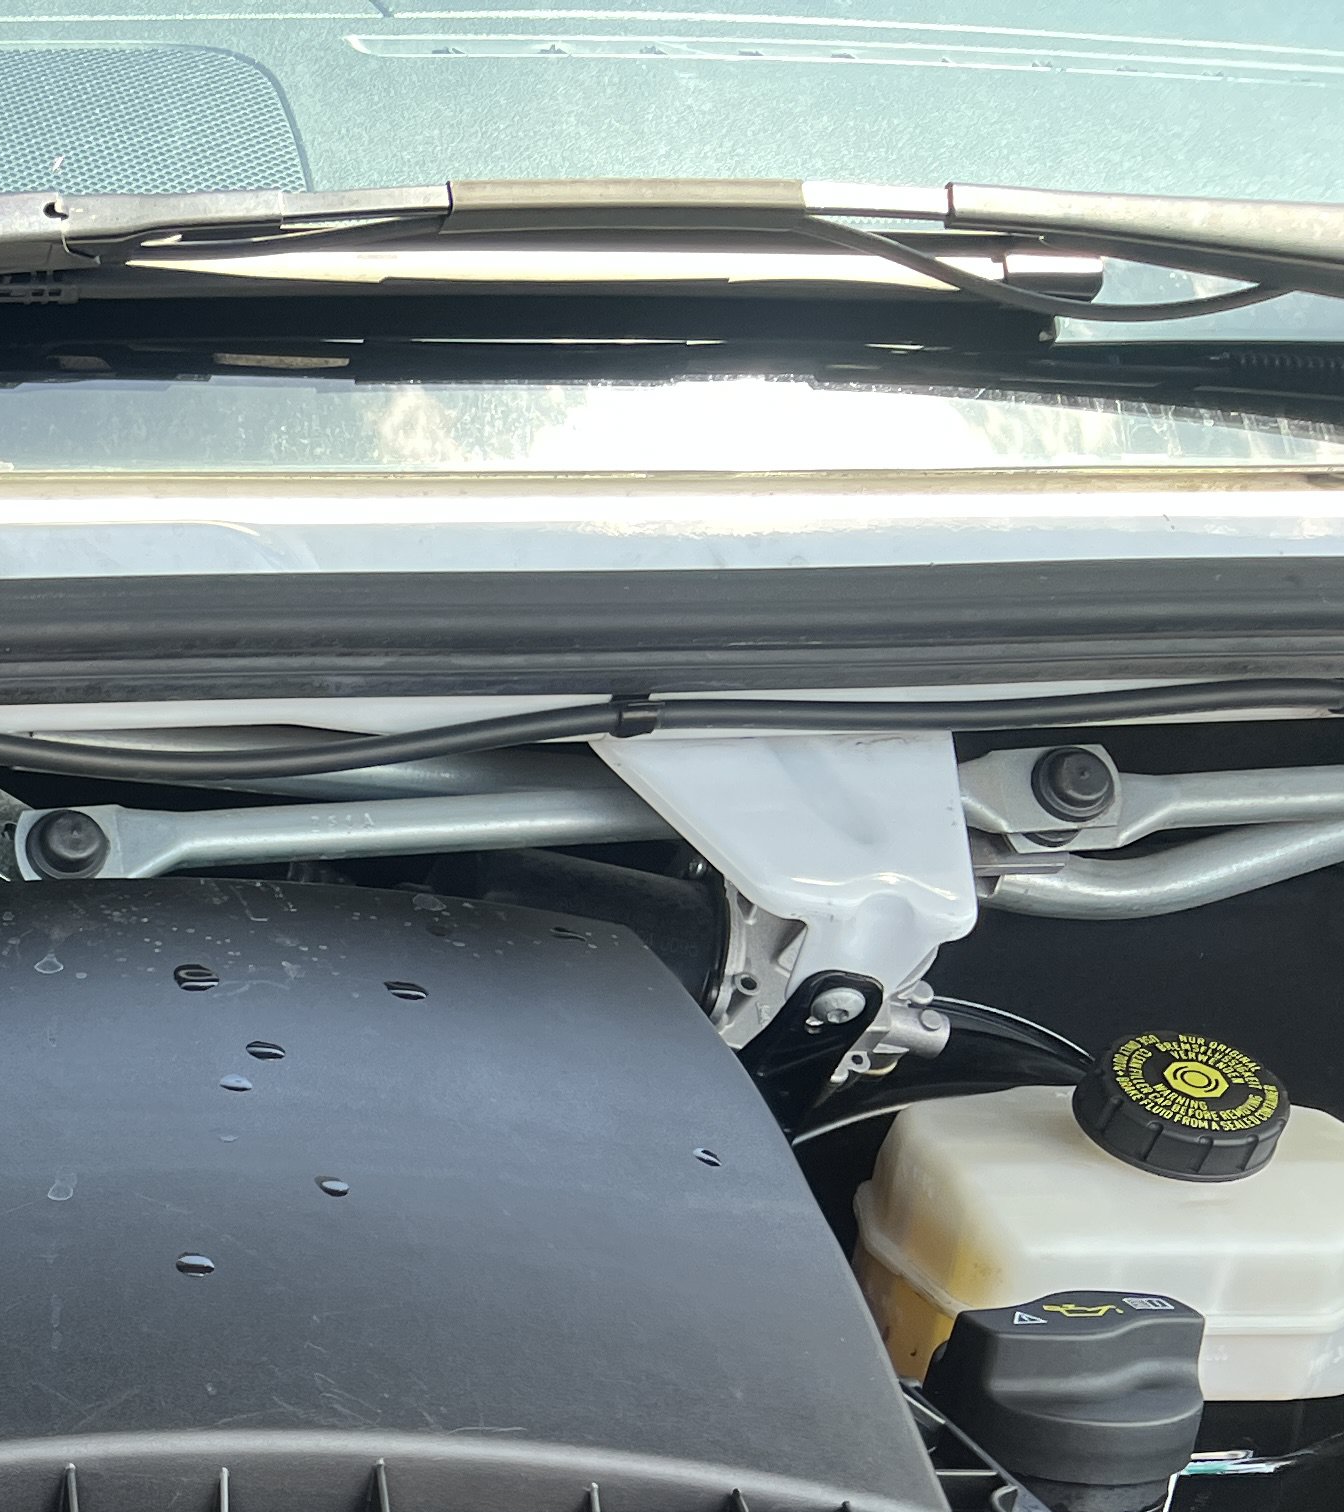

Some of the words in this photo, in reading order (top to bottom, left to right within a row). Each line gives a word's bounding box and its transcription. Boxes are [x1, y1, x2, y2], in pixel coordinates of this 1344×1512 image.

[1179, 1035, 1205, 1045] NUR
[1209, 1041, 1261, 1071] ORIGINAL
[1115, 1077, 1145, 1101] BRAKE
[1139, 1098, 1174, 1119] FLUID
[1174, 1115, 1209, 1130] FROM
[1211, 1121, 1220, 1130] A
[1220, 1116, 1261, 1131] SEALED
[1148, 1091, 1172, 1106] CAP
[1172, 1104, 1220, 1121] BEFORE
[1153, 1083, 1208, 1111] WARNING
